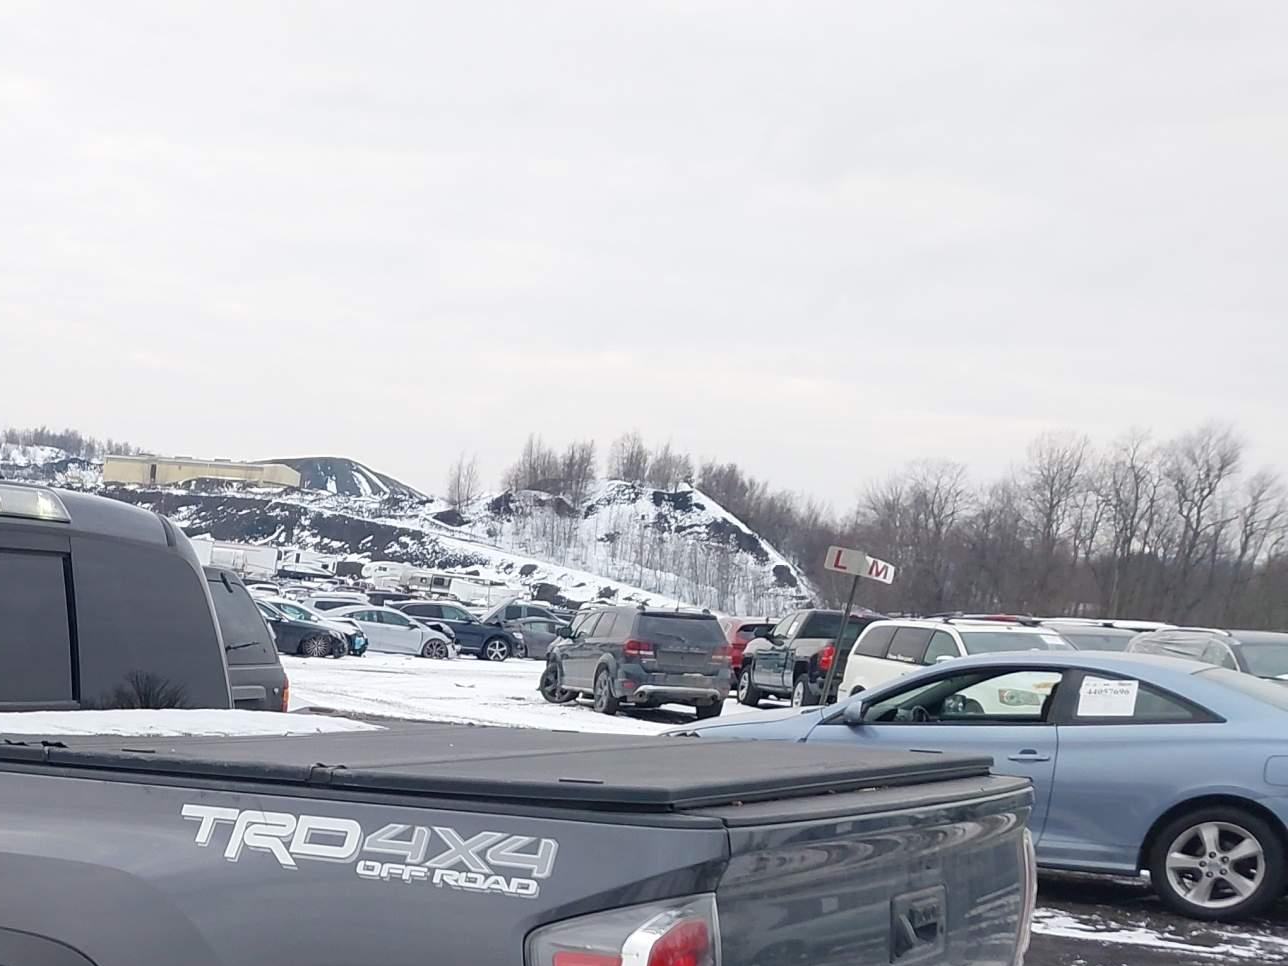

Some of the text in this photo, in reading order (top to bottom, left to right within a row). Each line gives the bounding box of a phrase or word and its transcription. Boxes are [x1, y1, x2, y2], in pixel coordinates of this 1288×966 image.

[833, 549, 889, 580] L M
[180, 803, 364, 871] TRD
[355, 859, 541, 899] OFF ROAD
